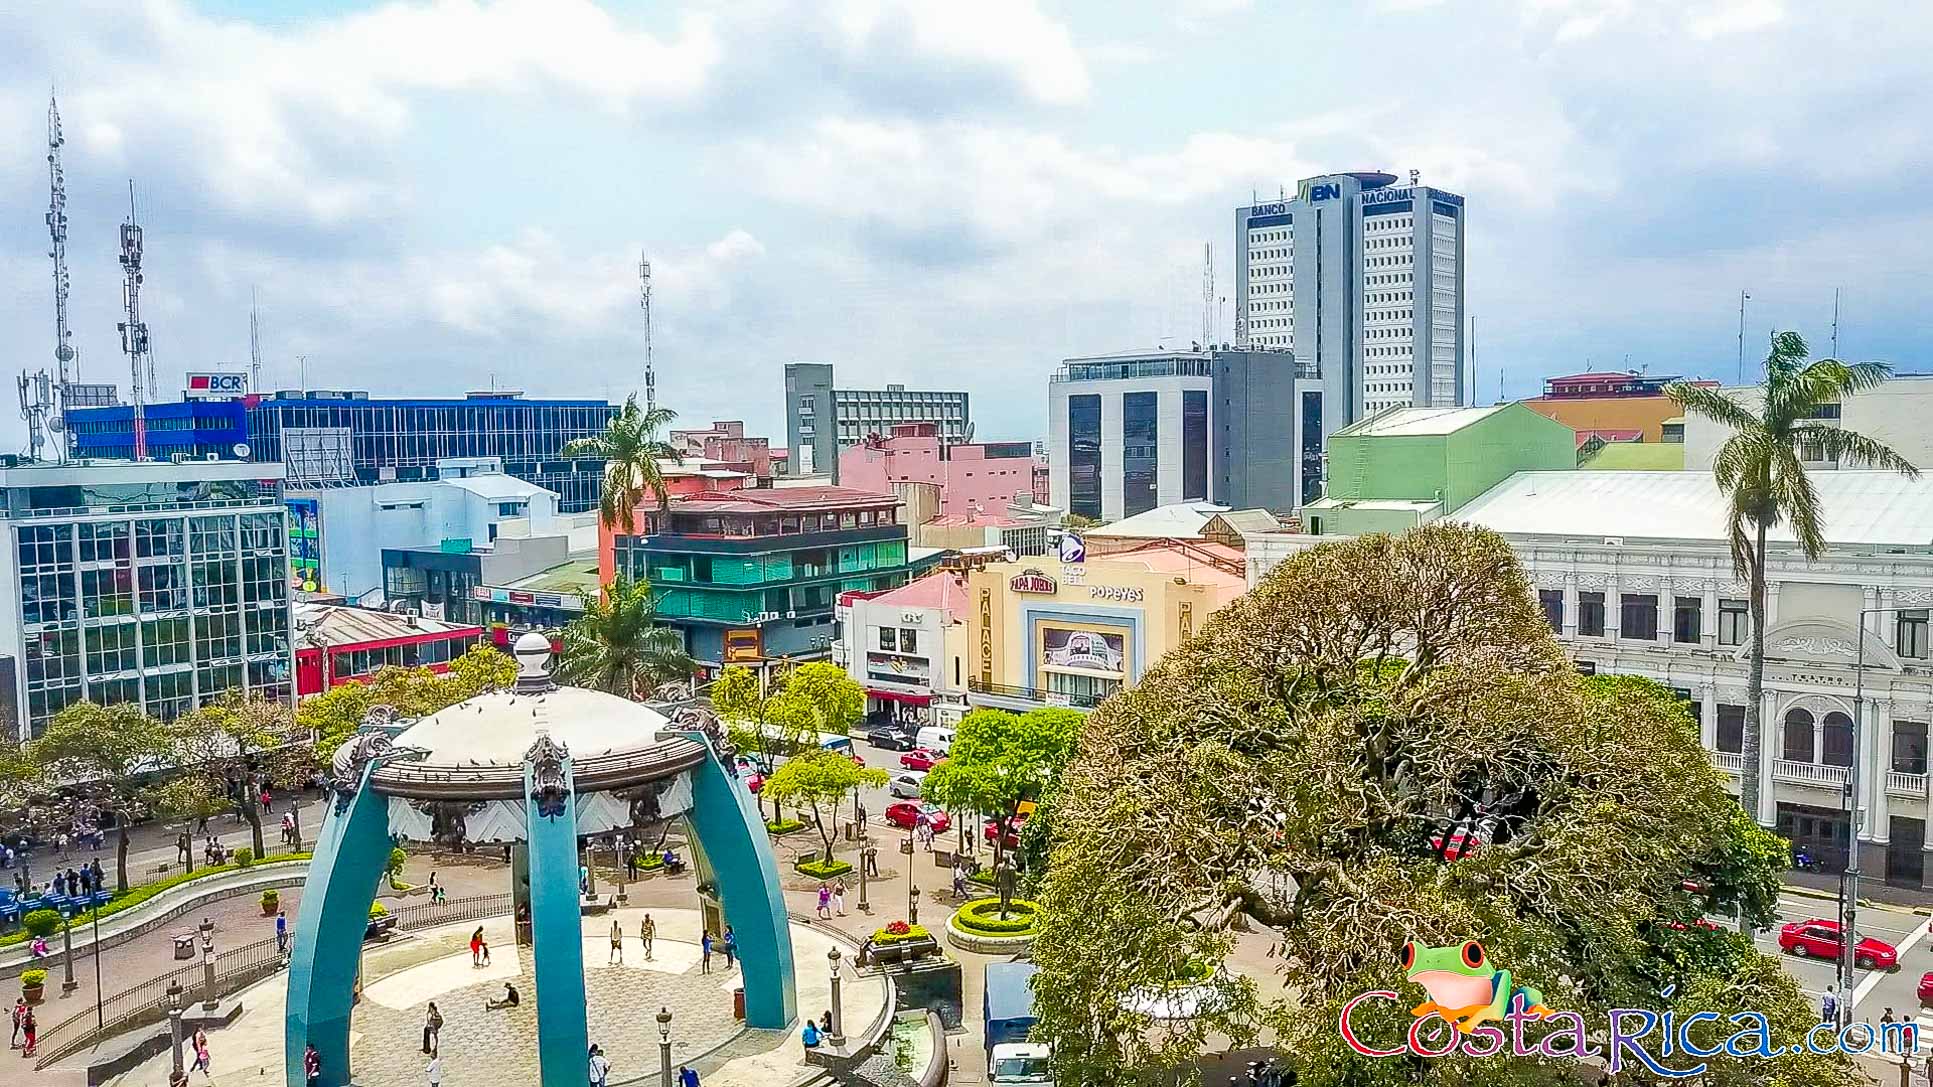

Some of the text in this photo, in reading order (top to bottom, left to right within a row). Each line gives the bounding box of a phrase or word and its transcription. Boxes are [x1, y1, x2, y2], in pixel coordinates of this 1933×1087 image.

[1311, 183, 1340, 201] BN
[1251, 203, 1286, 217] BANCO
[1361, 188, 1416, 205] NACIONAL
[210, 375, 241, 389] BCR
[1061, 566, 1087, 576] TACO
[1010, 576, 1029, 591] PAPA
[981, 587, 992, 673] PALACE
[1791, 673, 1843, 683] TEATRO
